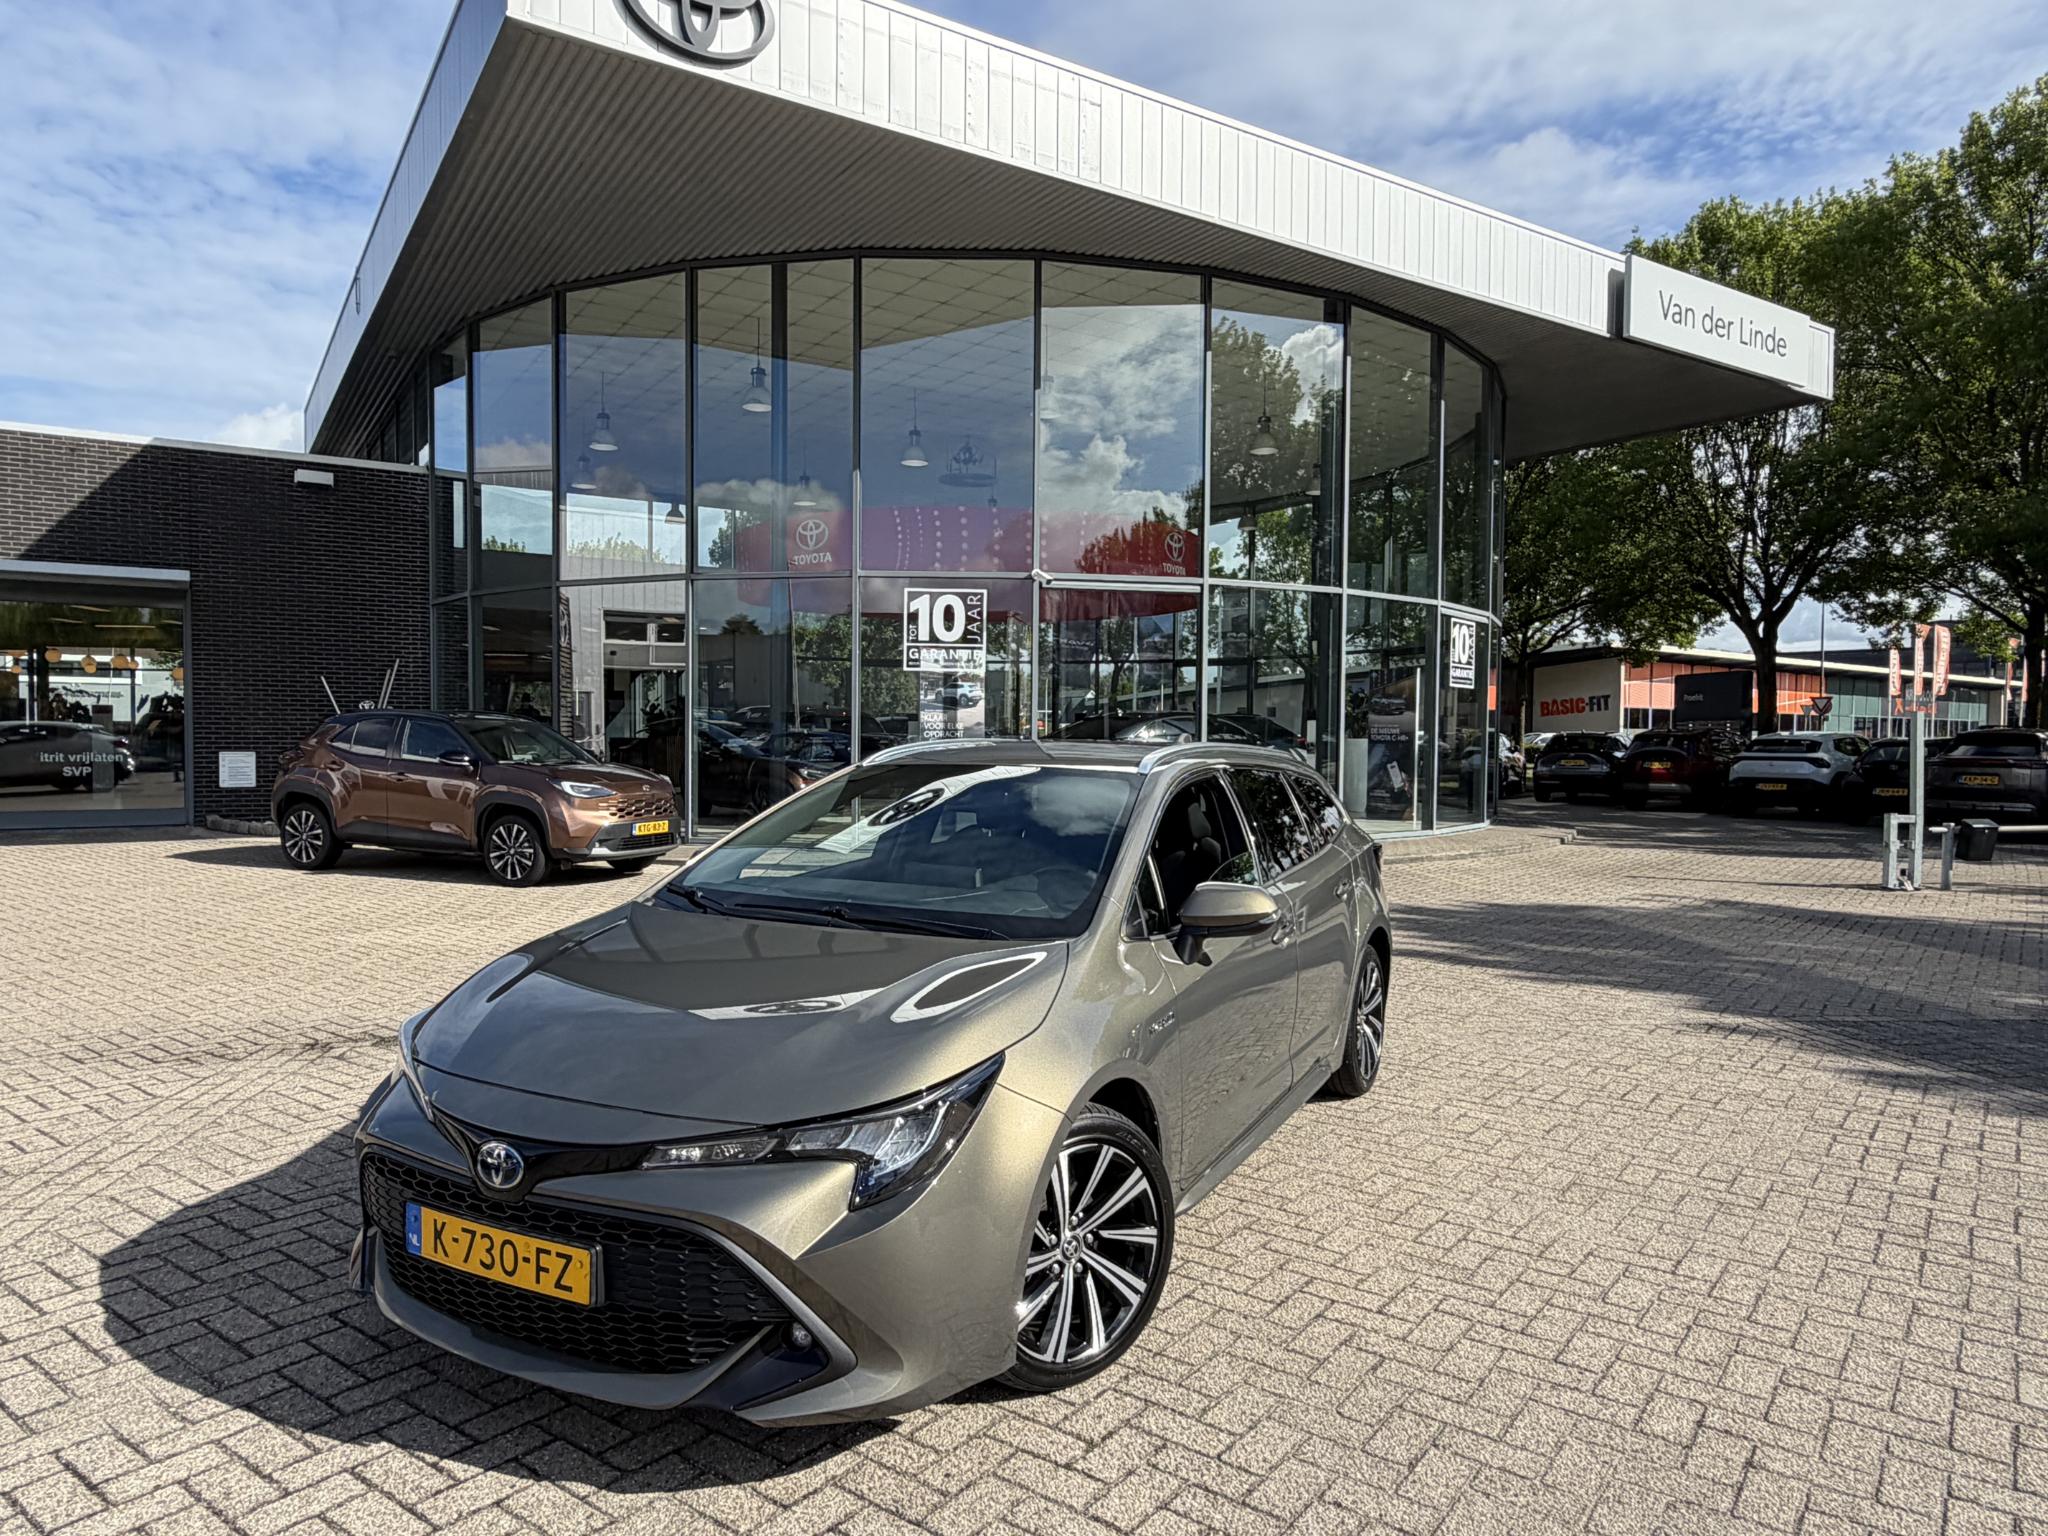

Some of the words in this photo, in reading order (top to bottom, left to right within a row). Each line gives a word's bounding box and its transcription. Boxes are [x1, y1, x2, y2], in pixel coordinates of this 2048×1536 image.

[1659, 290, 1696, 329] Van
[1701, 306, 1734, 340] der
[1739, 317, 1788, 357] Linde
[793, 551, 833, 565] TOYOTA
[1162, 562, 1186, 576] TOYOTA
[909, 593, 966, 643] 10
[967, 594, 982, 642] JAAR
[909, 624, 917, 640] TOT
[1452, 623, 1469, 664] 10
[908, 647, 982, 661] GARANTIE
[924, 730, 964, 738] OPDRACHT
[68, 752, 124, 764] vrijlaten
[62, 766, 92, 777] SVP
[408, 1233, 420, 1247] NL
[433, 1218, 574, 1293] K-730-FZ
